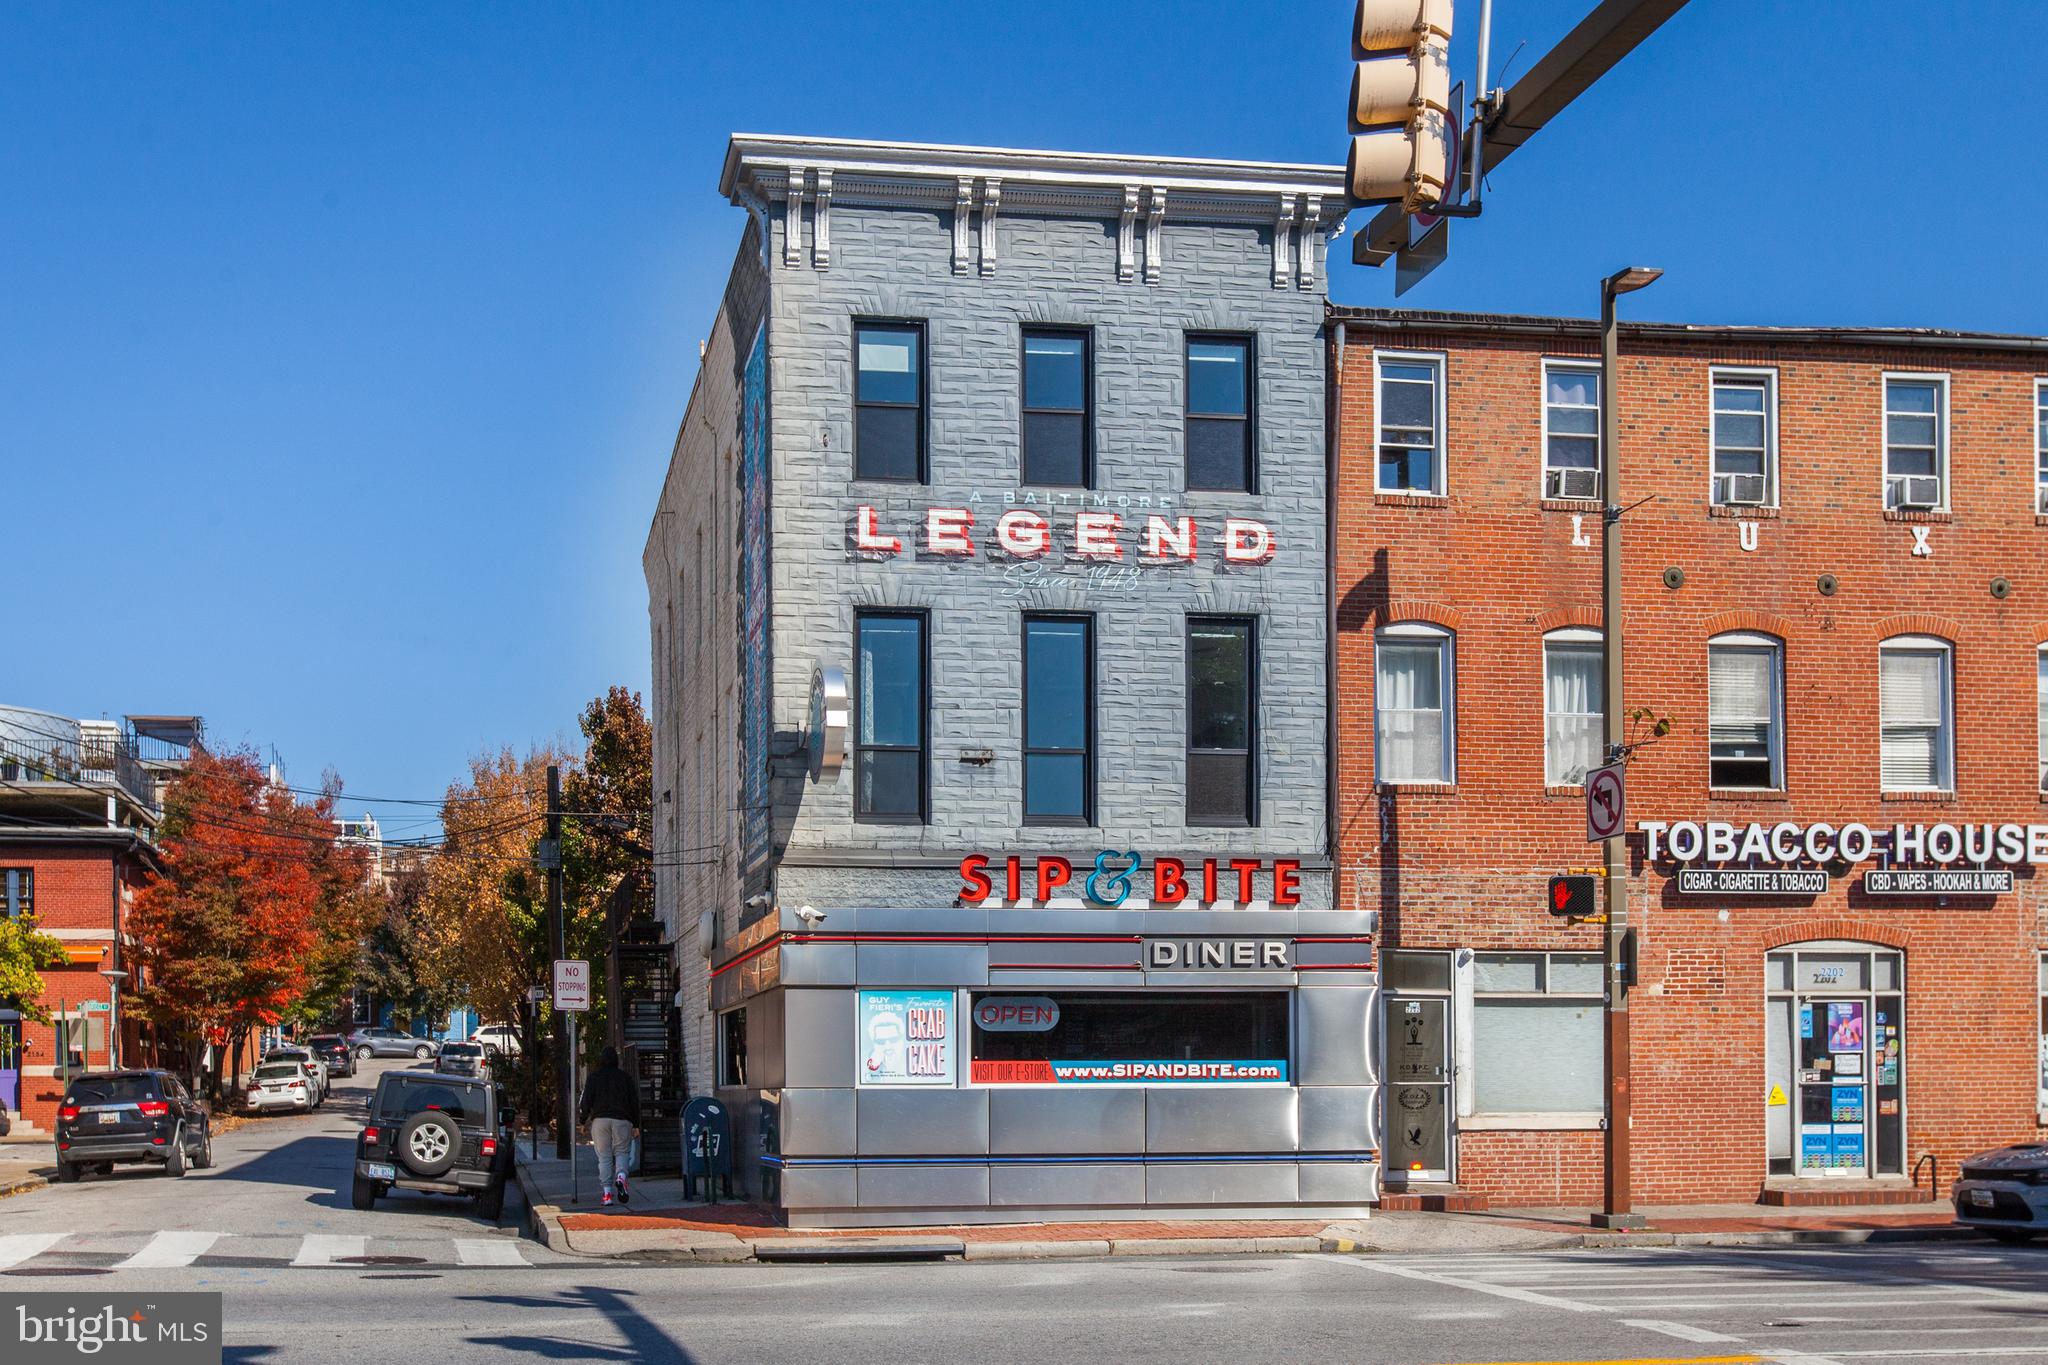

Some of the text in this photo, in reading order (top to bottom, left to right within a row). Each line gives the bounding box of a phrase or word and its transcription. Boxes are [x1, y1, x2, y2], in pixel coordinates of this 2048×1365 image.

[969, 490, 1172, 508] A BALTIMORE
[855, 504, 1277, 567] LEGEND
[1001, 561, 1141, 597] Since 1948
[1636, 820, 2048, 864] TOBACCO HOUSE
[958, 849, 1302, 906] SIP & BITE
[1683, 872, 1713, 890] CIGAR
[1719, 872, 1770, 891] CIGARETTE
[1771, 873, 1778, 891] &
[1780, 873, 1824, 891] TOBACCO
[1871, 873, 1891, 890] CBD
[1897, 873, 1927, 890] VAPES
[1933, 873, 1972, 890] HOOKAH
[1973, 873, 1981, 890] &
[1982, 873, 2009, 890] MORE
[1151, 940, 1289, 968] DINER
[565, 967, 579, 977] NO
[1820, 967, 1845, 977] 2202
[558, 981, 587, 992] STOPPING
[868, 996, 890, 1004] GUY
[869, 1003, 903, 1011] FIERI'S
[907, 1007, 946, 1040] CRAB
[980, 1005, 1053, 1024] OPEN
[907, 1043, 946, 1076] CAKE
[974, 1063, 1049, 1081] VISIT OUR E-STORE
[1055, 1063, 1280, 1079] www.SIPANDBITE.com
[1837, 1089, 1858, 1098] ZYN
[1806, 1136, 1827, 1146] ZYN
[1837, 1136, 1859, 1146] ZYN
